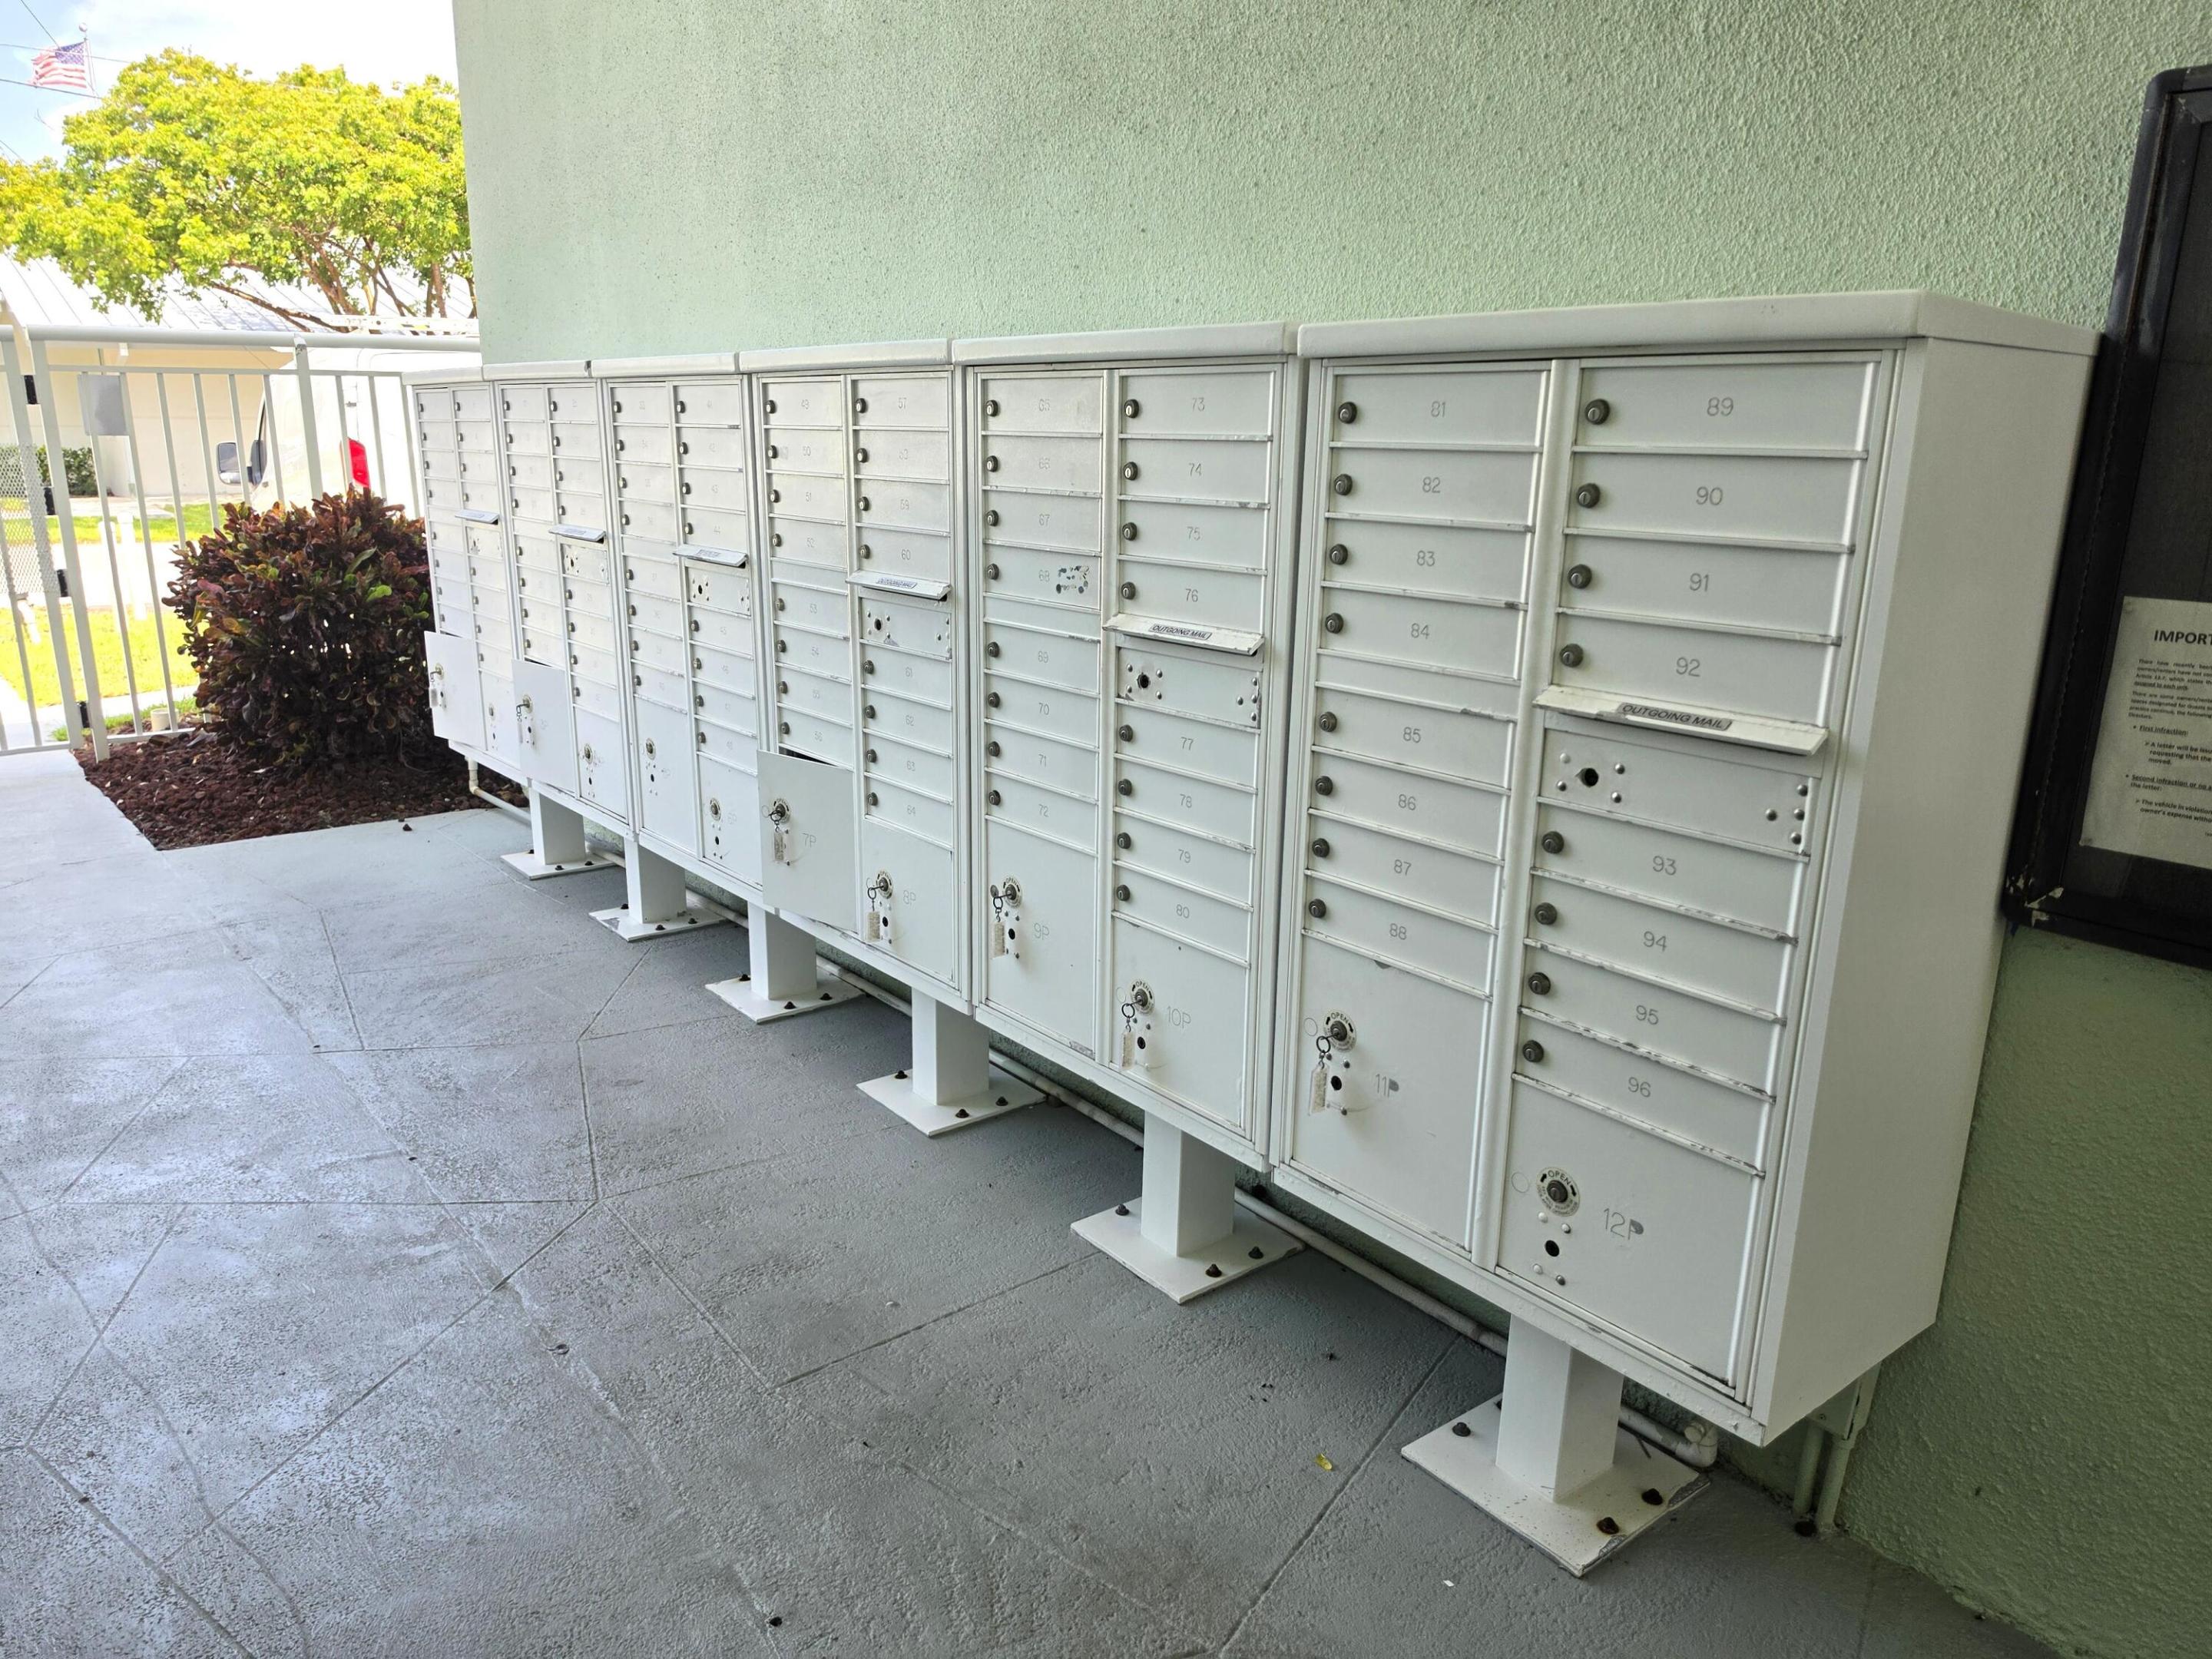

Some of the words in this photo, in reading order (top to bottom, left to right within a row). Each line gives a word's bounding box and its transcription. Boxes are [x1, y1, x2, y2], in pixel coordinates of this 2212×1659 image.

[1192, 398, 1206, 412] 73
[1431, 401, 1446, 418] 81
[1707, 397, 1734, 417] 89
[1189, 462, 1203, 477] 74
[1422, 477, 1441, 493] 82
[1696, 486, 1723, 505] 90
[1187, 526, 1200, 541] 75
[901, 549, 911, 561] 60
[1416, 550, 1435, 567] 83
[1690, 573, 1710, 591] 91
[1185, 588, 1198, 603] 76
[1153, 625, 1191, 636] OUTGOING
[1410, 623, 1430, 640] 84
[1675, 657, 1701, 677] 92
[1038, 702, 1049, 716] 70
[1623, 705, 1691, 722] OUTGOING
[1692, 717, 1724, 728] MAIL
[1402, 726, 1421, 743] 85
[1181, 737, 1194, 750] 77
[1038, 754, 1048, 768] 71
[2150, 750, 2184, 759] requesting
[2131, 774, 2155, 783] Second
[2156, 777, 2188, 787] infraction
[1179, 793, 1193, 807] 78
[1398, 793, 1417, 811] 86
[1038, 804, 1049, 818] 72
[1177, 849, 1191, 863] 79
[1393, 859, 1412, 876] 87
[1652, 855, 1677, 876] 93
[1176, 904, 1190, 919] 80
[1034, 922, 1050, 940] 9P
[1389, 922, 1407, 940] 88
[1643, 931, 1667, 952] 94
[1167, 1006, 1191, 1029] 10P
[1330, 1012, 1349, 1024] OPEN
[1635, 1005, 1660, 1025] 95
[1628, 1077, 1651, 1098] 96
[1548, 1170, 1571, 1185] OPEN
[1603, 1207, 1644, 1240] 12P
